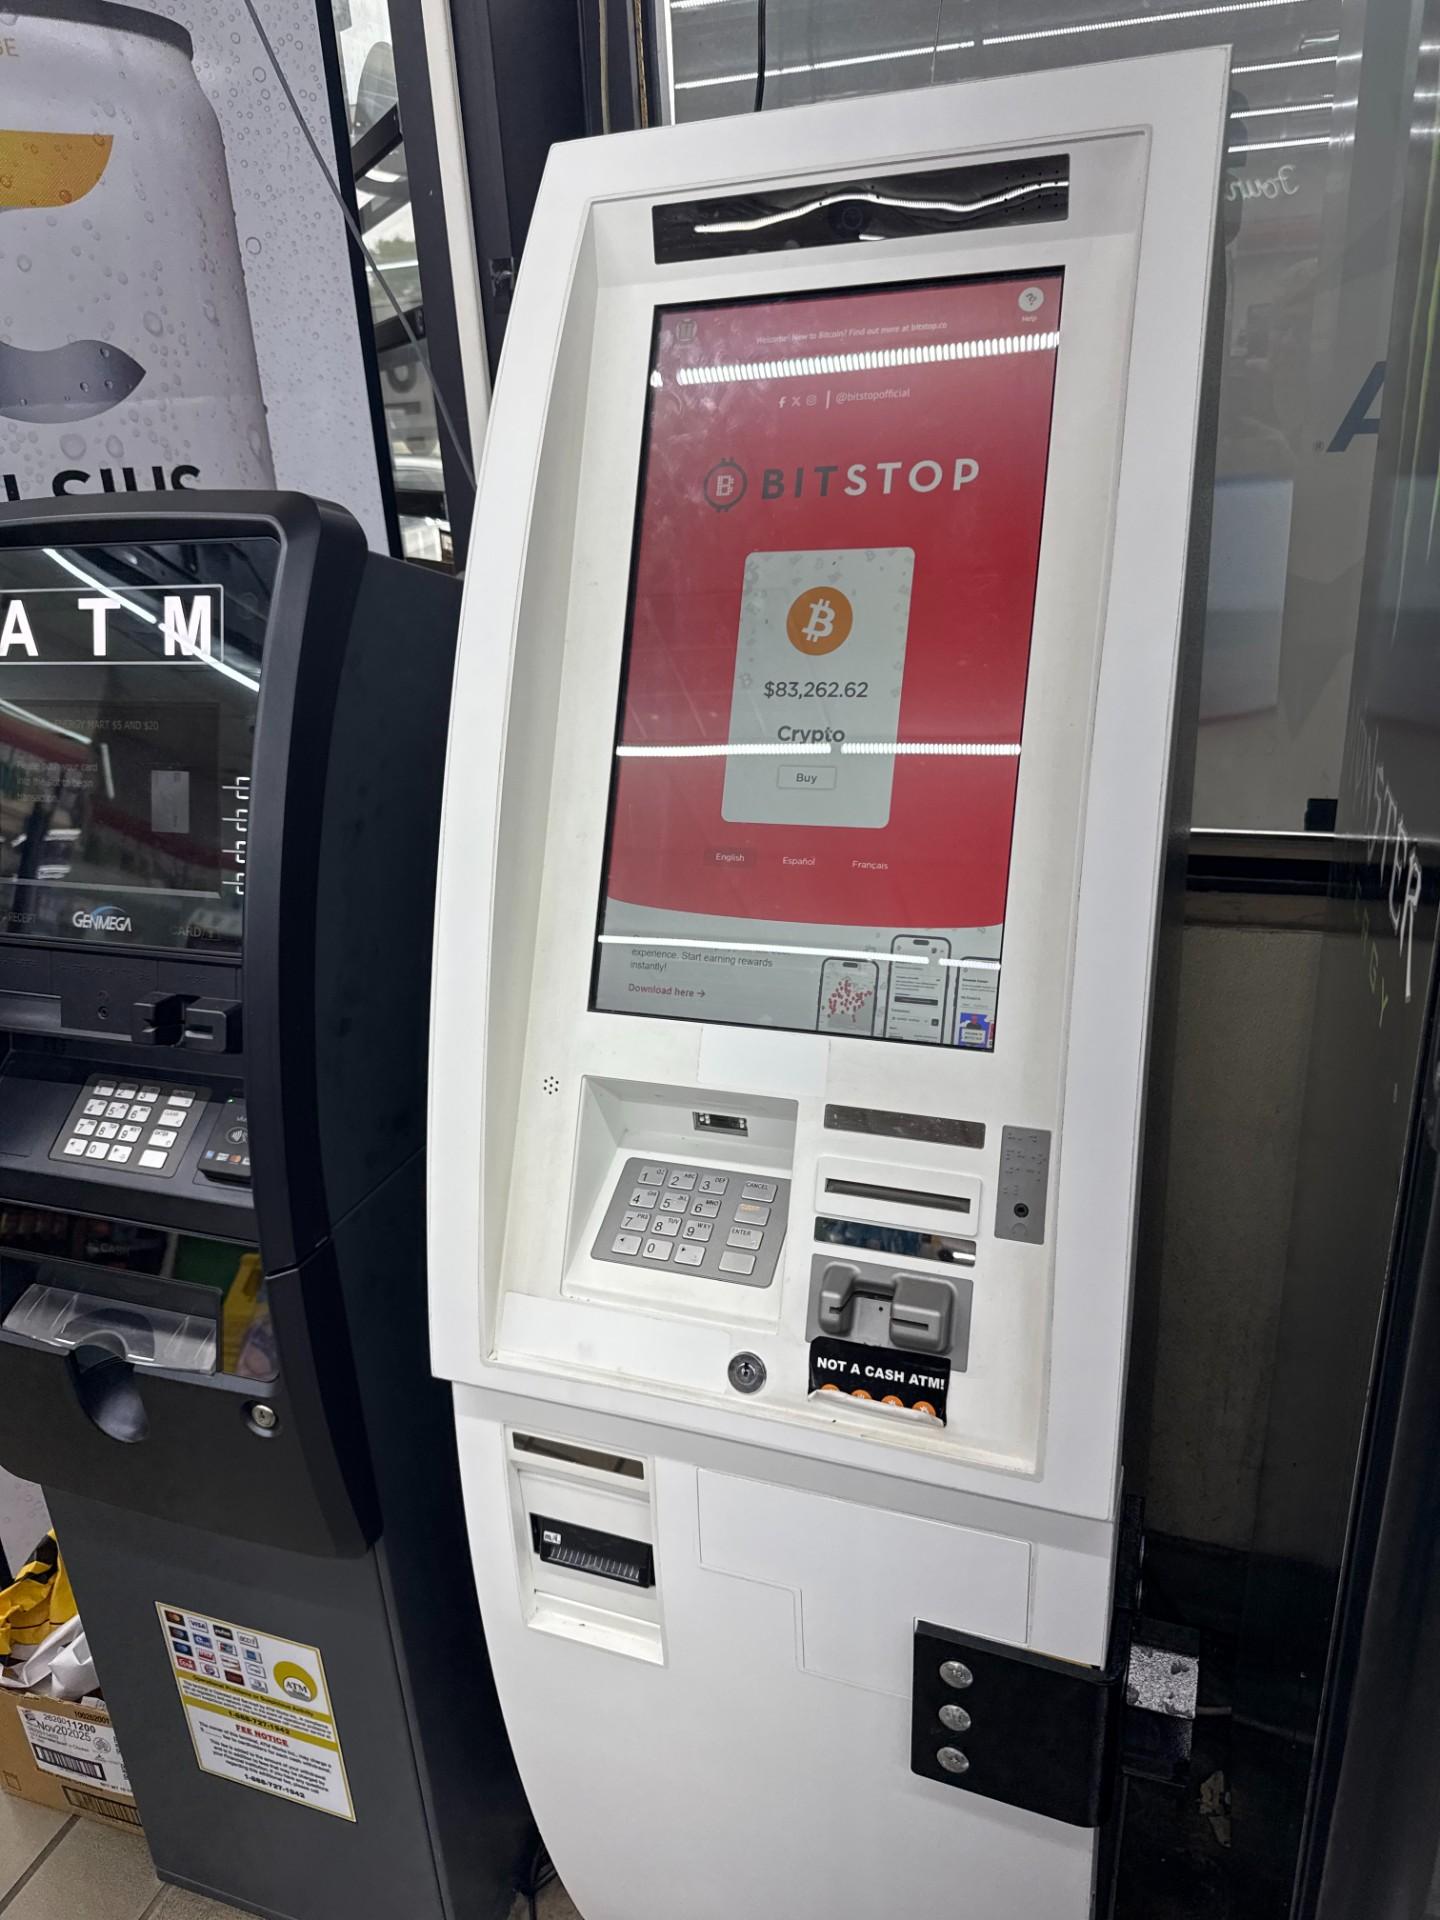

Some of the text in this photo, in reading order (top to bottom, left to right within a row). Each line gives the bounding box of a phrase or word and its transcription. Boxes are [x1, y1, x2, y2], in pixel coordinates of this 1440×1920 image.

[849, 328, 865, 336] Find
[867, 327, 880, 335] out
[836, 387, 911, 404] @bitstopofficial
[762, 457, 980, 499] BITSTOP
[764, 681, 868, 699] $83,262.62
[125, 720, 142, 730] AND
[777, 725, 845, 746] Crypto
[796, 772, 818, 785] Buy
[715, 852, 745, 864] English
[782, 855, 816, 867] Español
[72, 911, 133, 932] GENMEGA
[631, 947, 773, 968] experience. Start earning rewards
[630, 960, 667, 973] instantly!
[628, 983, 695, 998] Download here
[642, 1172, 648, 1182] 1
[671, 1176, 680, 1186] 2
[703, 1180, 711, 1190] 3
[746, 1182, 769, 1190] CANCEL
[633, 1194, 641, 1204] 4
[662, 1198, 671, 1209] 5
[695, 1203, 703, 1213] 6
[624, 1216, 633, 1227] 7
[654, 1221, 663, 1232] 8
[686, 1226, 695, 1237] 9
[732, 1228, 752, 1236] ENTER
[647, 1243, 656, 1254] 0
[817, 1356, 945, 1390] NOT A CASH ATM!
[286, 1679, 307, 1694] ATM
[235, 1723, 288, 1747] FEE NOTICE
